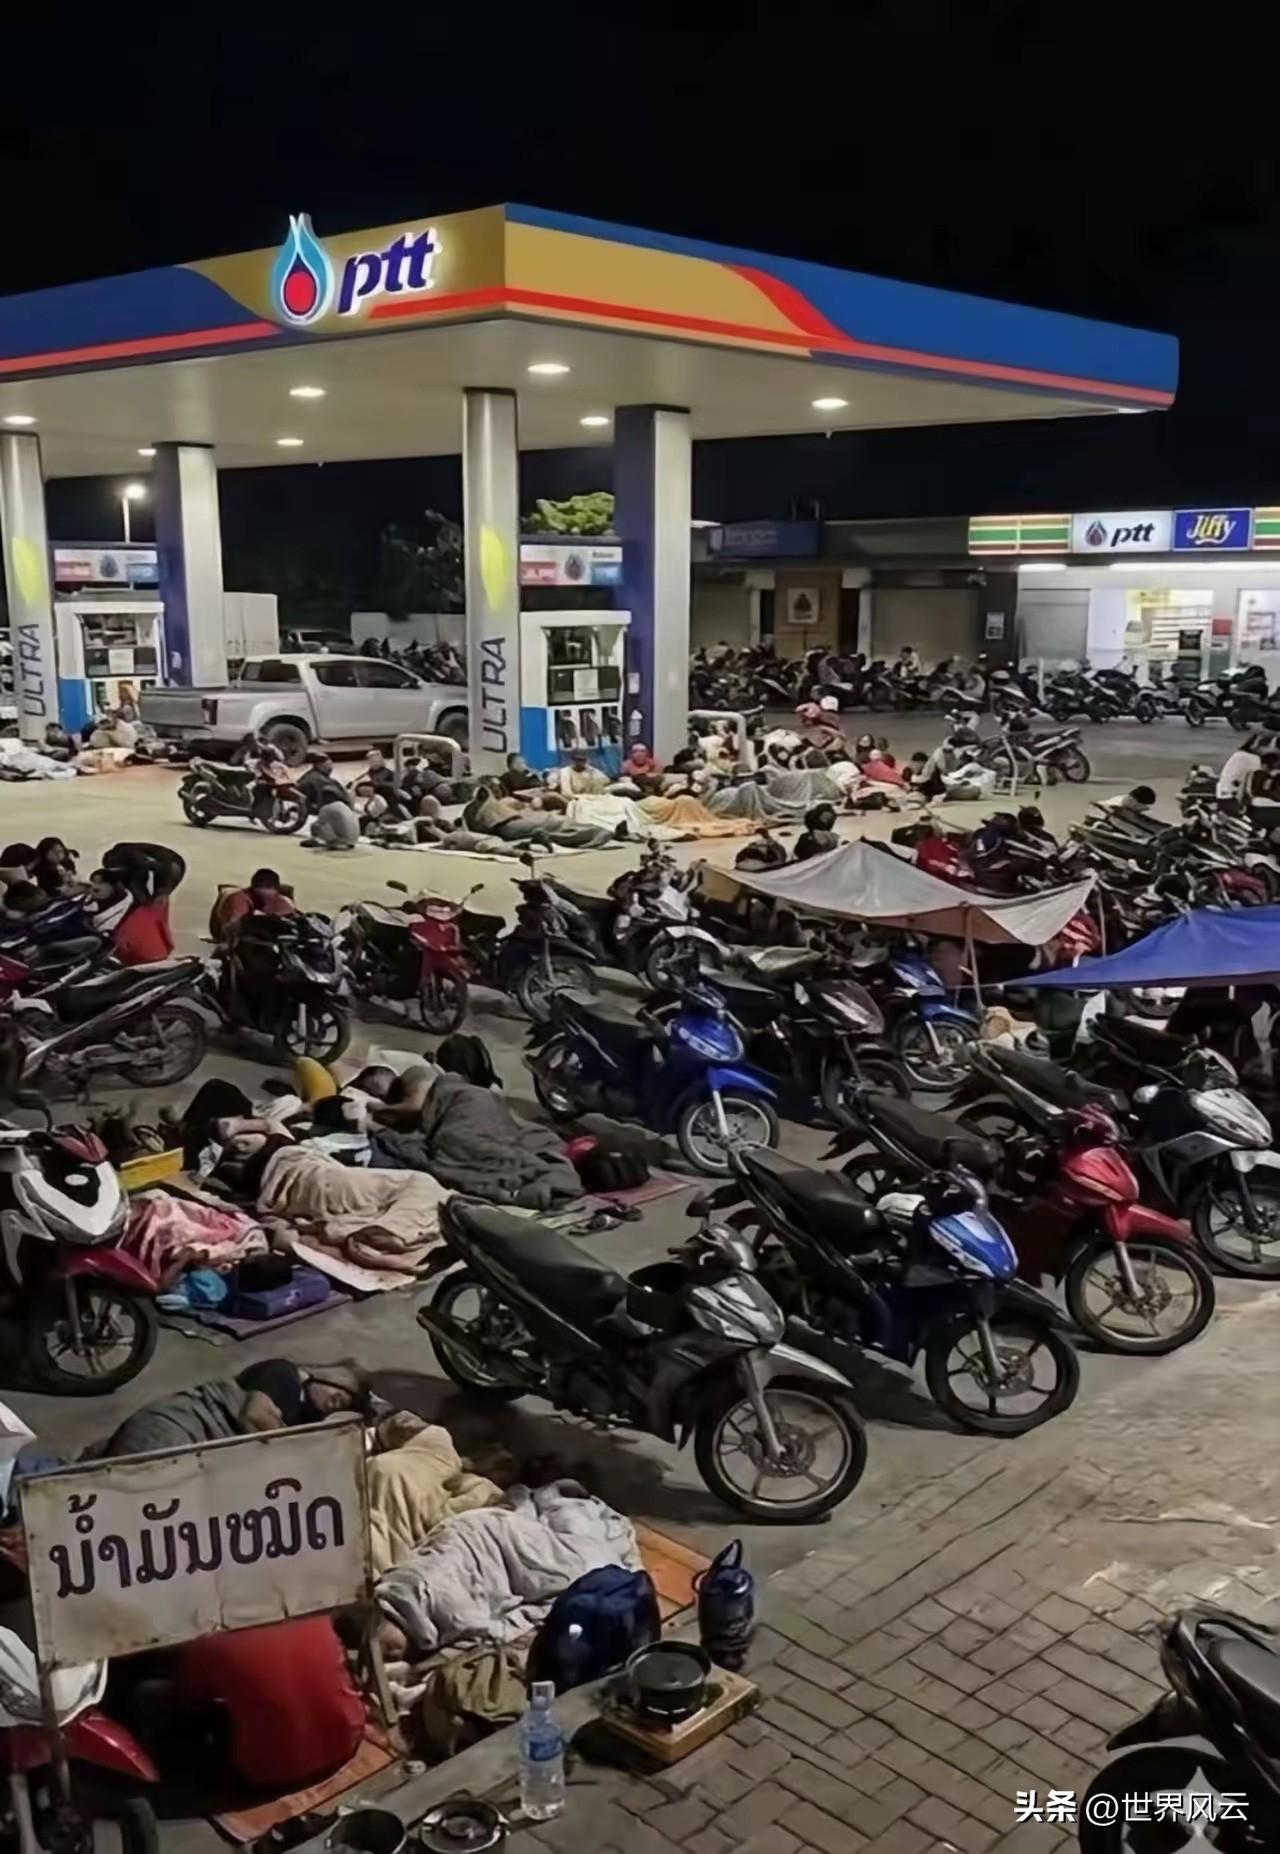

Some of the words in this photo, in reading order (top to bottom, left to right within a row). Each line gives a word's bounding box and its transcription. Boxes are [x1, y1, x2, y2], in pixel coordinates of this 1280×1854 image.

[337, 228, 437, 314] ptt
[1110, 522, 1155, 547] ptt
[1186, 514, 1237, 545] Jiffy
[19, 624, 46, 717] ULTRA
[481, 637, 507, 753] ULTRA
